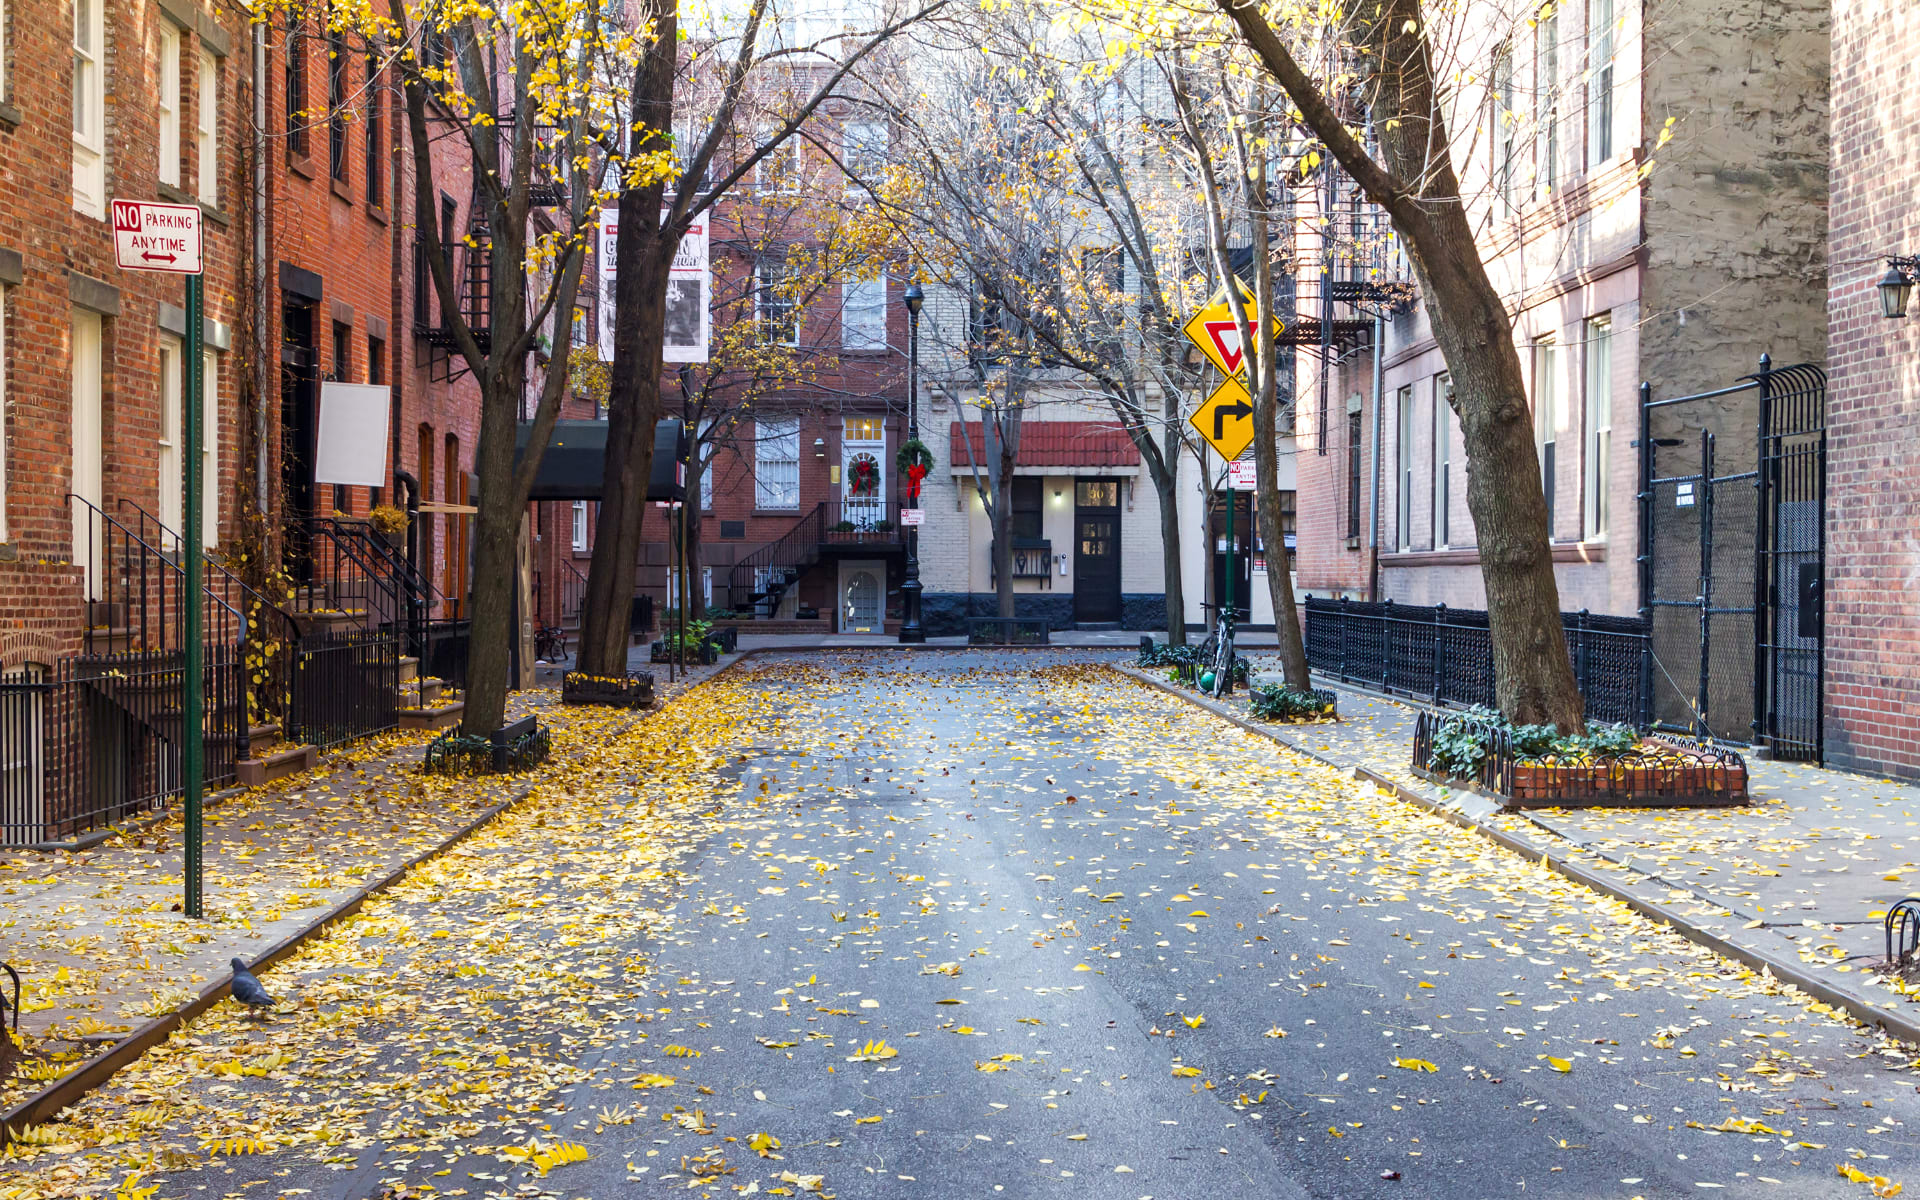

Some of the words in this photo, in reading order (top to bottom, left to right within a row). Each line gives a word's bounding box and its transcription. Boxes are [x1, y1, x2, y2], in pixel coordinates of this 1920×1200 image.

[115, 204, 140, 229] NO
[145, 213, 192, 229] PARKING
[131, 235, 187, 252] ANYTIME
[1230, 463, 1240, 473] NO
